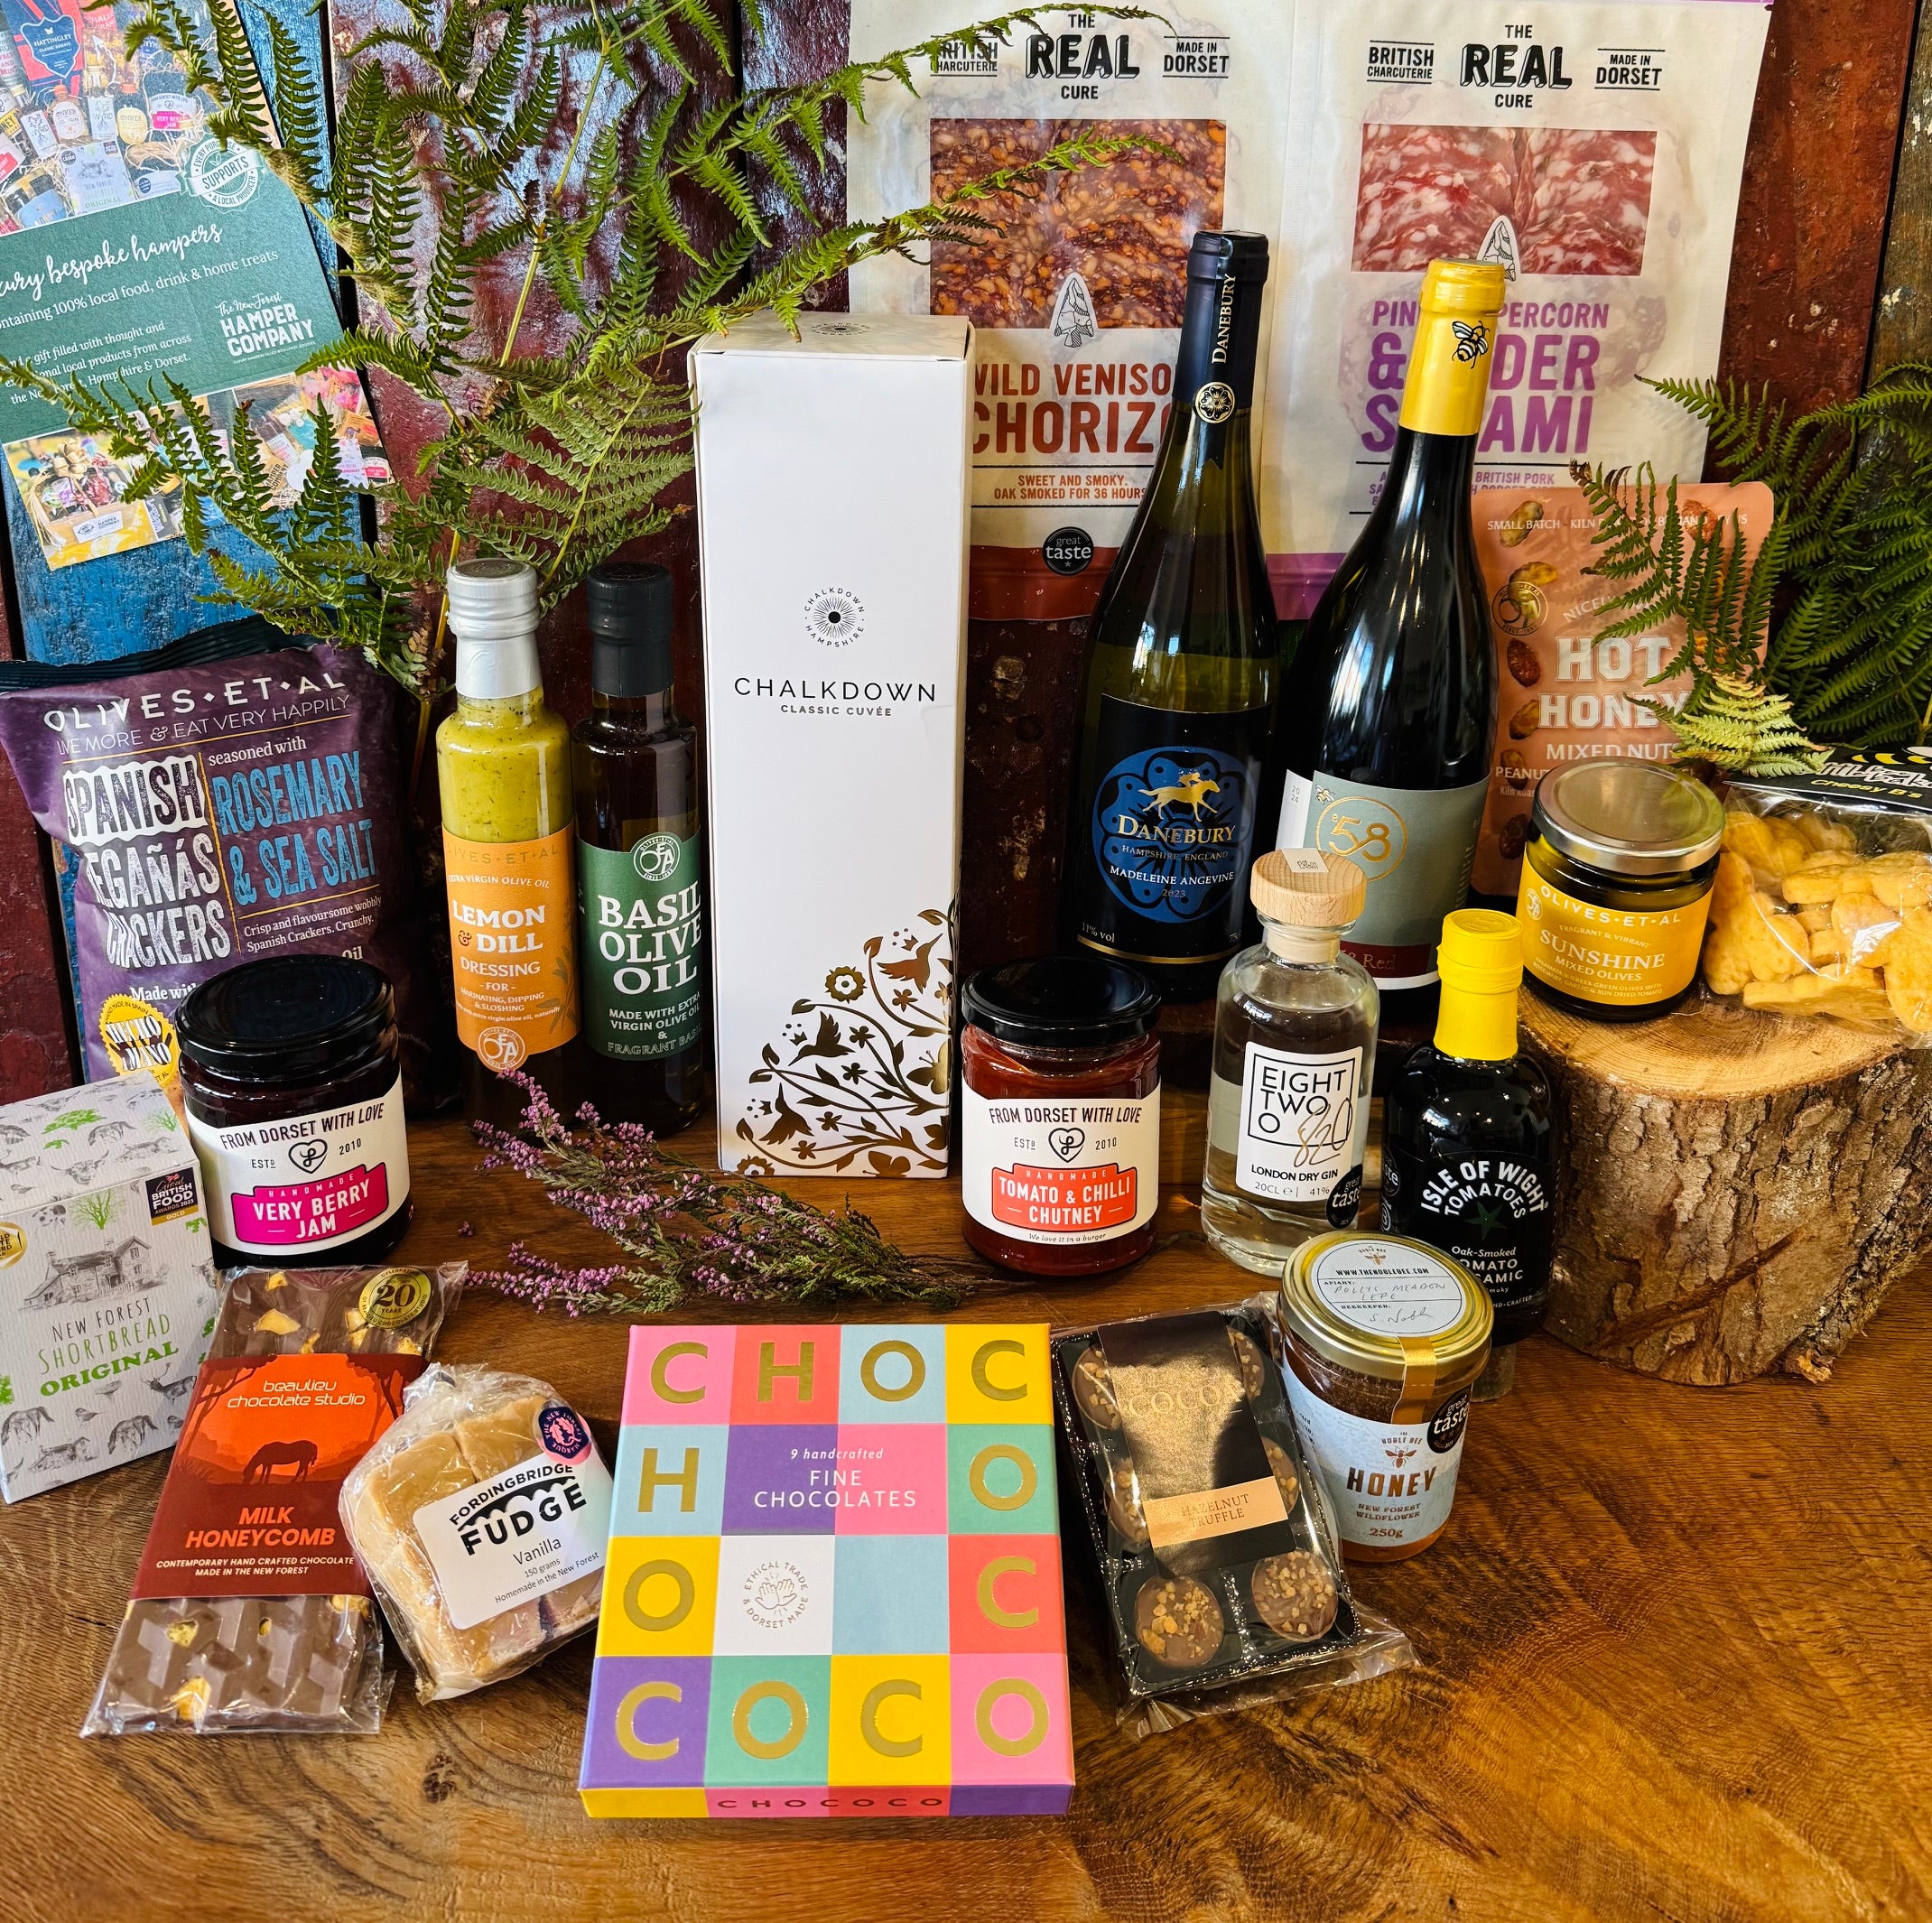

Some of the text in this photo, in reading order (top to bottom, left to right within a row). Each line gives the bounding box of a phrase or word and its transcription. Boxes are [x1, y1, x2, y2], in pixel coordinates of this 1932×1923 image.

[1068, 14, 1095, 28] THE
[1505, 24, 1532, 38] THE
[1026, 34, 1139, 79] REAL
[1176, 42, 1217, 53] MADE IN
[1369, 47, 1434, 67] BRITISH
[1164, 55, 1230, 74] DORSET
[1460, 43, 1573, 89] REAL
[1610, 54, 1651, 66] MADE IN
[1367, 66, 1433, 79] CHARCUTERIE
[1595, 67, 1663, 86] DORSET
[1061, 86, 1099, 100] CURE
[1494, 94, 1533, 108] CURE
[201, 155, 250, 190] SUPPORTS
[46, 224, 223, 285] bespoke hampers
[53, 249, 279, 316] 100% local food, drink home treats
[219, 302, 299, 339] HAMPER
[1212, 274, 1237, 365] DANEBURY
[105, 320, 166, 346] thought and
[227, 319, 315, 358] COMPANY
[89, 334, 192, 368] products across
[1367, 332, 1407, 391] &
[1017, 475, 1129, 487] SWEET AND SMOKY.
[1475, 471, 1555, 485] BRITISH PORK
[994, 488, 1108, 500] OAK SMOKED FOR 36
[1487, 519, 1561, 531] SMALL BATCH
[1045, 543, 1091, 561] taste
[1055, 535, 1082, 548] great
[1556, 636, 1671, 682] HOT
[734, 677, 936, 702] CHALKDOWN
[780, 704, 893, 717] CLASSIC CUVÉE
[85, 694, 351, 752] MORE EAT VERY HAPPILY
[208, 736, 308, 766] seasoned with
[1546, 743, 1623, 760] MIXED
[213, 750, 364, 837] ROSEMARY
[1810, 779, 1888, 793] Cheesy
[66, 760, 205, 840] SPANISH
[1117, 813, 1236, 844] DANEBURY
[228, 819, 378, 906] & SEA SALT
[1122, 844, 1229, 861] HAMPSHIRE ENGLAND
[466, 875, 532, 887] VIRGIN OLIVE
[1110, 865, 1235, 886] MADELEINE ANGEVINE
[452, 899, 546, 929] LEMON
[598, 879, 701, 930] BASIL
[244, 904, 354, 938] Crisp and flavoursome
[102, 899, 231, 969] CRACKERS
[246, 915, 375, 953] Spanish Crackers. Crunchy.
[458, 930, 543, 953] & DILL
[599, 915, 701, 963] OLIVE
[1539, 929, 1666, 971] SUNSHINE
[460, 956, 542, 978] DRESSING
[613, 954, 697, 995] OIL
[1555, 955, 1642, 981] MIXED OLIVES
[129, 986, 168, 1001] Made
[508, 992, 544, 1004] DIPPING
[608, 990, 701, 1020] MADE WITH EXTRA
[610, 1012, 687, 1032] VIRGIN OLIVE
[608, 1040, 677, 1055] FRAGRANT
[1261, 1066, 1348, 1092] EIGHT
[1259, 1088, 1328, 1117] TWO
[219, 1102, 385, 1151] FROM DORSET WITH LOVE
[989, 1107, 1142, 1124] FROM DORSET WITH LOVE
[339, 1138, 362, 1156] 2010
[1095, 1137, 1118, 1151] 2010
[1026, 1169, 1107, 1182] HANDMADE
[1250, 1164, 1339, 1182] LONDON DRY GIN
[151, 1183, 192, 1201] BRITISH
[269, 1173, 355, 1198] HANDMADE
[999, 1175, 1130, 1203] TOMATO & CHILLI
[1420, 1169, 1459, 1214] ISLE
[1459, 1160, 1490, 1179] OF
[1498, 1161, 1547, 1215] WIGHT
[153, 1190, 194, 1211] FOOD
[154, 1203, 181, 1215] AWARDS
[253, 1178, 370, 1222] VERY BERRY
[1444, 1183, 1528, 1220] TOMATOES
[295, 1212, 337, 1240] JAM
[1028, 1204, 1103, 1226] CHUTNEY
[1451, 1246, 1518, 1259] Oak-Smoked
[372, 1284, 416, 1307] 20
[51, 1296, 152, 1342] NEW FOREST
[38, 1313, 172, 1376] SHORTBREAD
[40, 1341, 180, 1398] ORIGINAL
[263, 1380, 338, 1393] beaulieu
[227, 1393, 366, 1409] chocolate studio
[803, 1447, 885, 1460] handcrafted
[810, 1470, 863, 1487] FINE
[1346, 1465, 1437, 1498] HONEY
[450, 1463, 573, 1526] FORDINGBRIDGE
[754, 1491, 917, 1509] CHOCOLATES
[1181, 1493, 1249, 1517] HAZELNUT
[238, 1506, 295, 1526] MILK
[1188, 1508, 1246, 1528] TRUFFLE
[1355, 1510, 1421, 1521] WILDFLOWER
[1358, 1502, 1422, 1513] NEW FOREST
[460, 1482, 588, 1556] FUDGE
[185, 1528, 337, 1550] HONEYCOMB
[1369, 1528, 1404, 1539] 250g
[513, 1537, 562, 1565] Vanilla
[155, 1556, 355, 1569] CONTEMPORARY HAND CRAFTED CHOCOLATE
[195, 1566, 310, 1577] MADE THE NEW FOREST
[539, 1557, 561, 1575] grams
[495, 1551, 600, 1603] Homemade Forest
[717, 1798, 943, 1809] CHOCOCO
